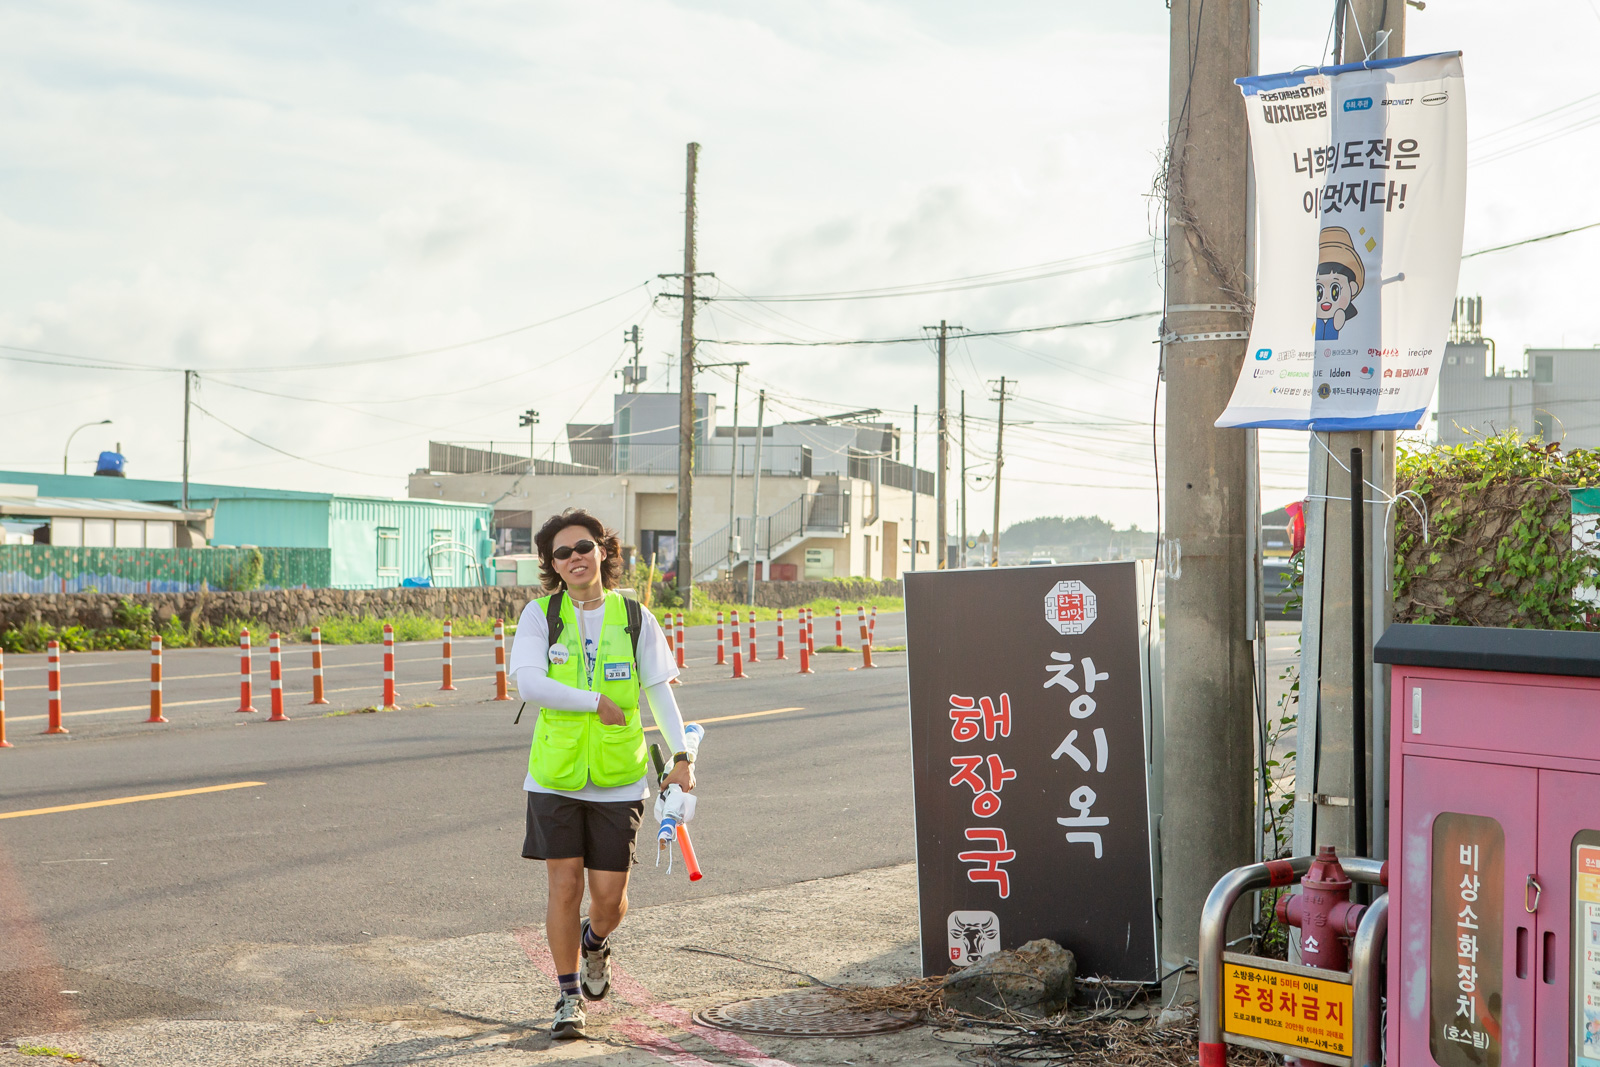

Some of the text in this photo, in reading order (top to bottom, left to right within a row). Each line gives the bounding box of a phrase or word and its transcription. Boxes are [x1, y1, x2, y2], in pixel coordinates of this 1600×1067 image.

[1262, 101, 1328, 124] 비치대장정
[1293, 138, 1420, 179] 너희의 도전은
[1303, 180, 1407, 219] 이 멋지다!
[1408, 348, 1433, 358] irecipe
[1395, 367, 1429, 378] 플레이사계
[1058, 594, 1081, 607] 한국
[1059, 607, 1083, 620] 의맛
[1043, 651, 1110, 860] 창시옥
[948, 691, 1016, 900] 해장국
[1456, 843, 1480, 1024] 비상소화장치
[1232, 969, 1319, 993] 소방용수시설 5미터 이내
[1233, 983, 1343, 1026] 주정차금지
[1233, 1012, 1344, 1040] 도로교통법 제32조 20만원 이하의 과태료
[1443, 1023, 1490, 1050] (호스릴)
[1296, 1035, 1345, 1052] 서부-사계-5호
